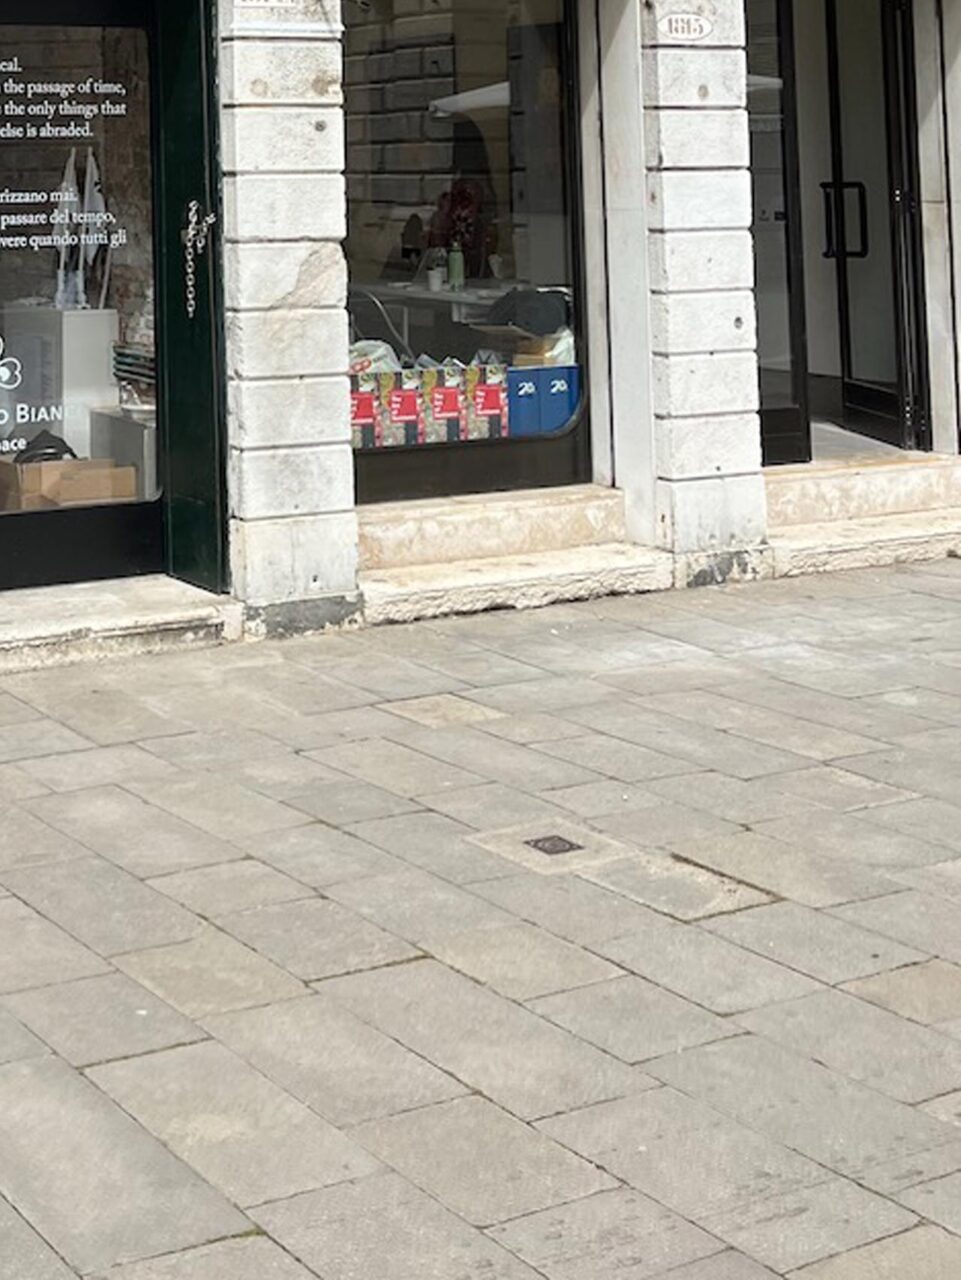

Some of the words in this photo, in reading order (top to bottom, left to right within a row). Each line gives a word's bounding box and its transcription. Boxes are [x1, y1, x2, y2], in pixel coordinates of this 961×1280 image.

[3, 78, 25, 94] the
[27, 81, 75, 98] passage
[77, 78, 92, 93] of
[93, 79, 127, 96] time,
[4, 100, 25, 116] the
[27, 100, 57, 119] only
[59, 100, 100, 120] things
[101, 100, 127, 115] that
[26, 122, 38, 138] is
[39, 122, 94, 138] abraded.
[50, 189, 79, 203] mai.
[0, 214, 47, 230] passare
[49, 209, 70, 223] del
[72, 211, 117, 227] tempo,
[29, 233, 79, 251] quando
[80, 231, 109, 246] tutti
[110, 230, 127, 249] gli
